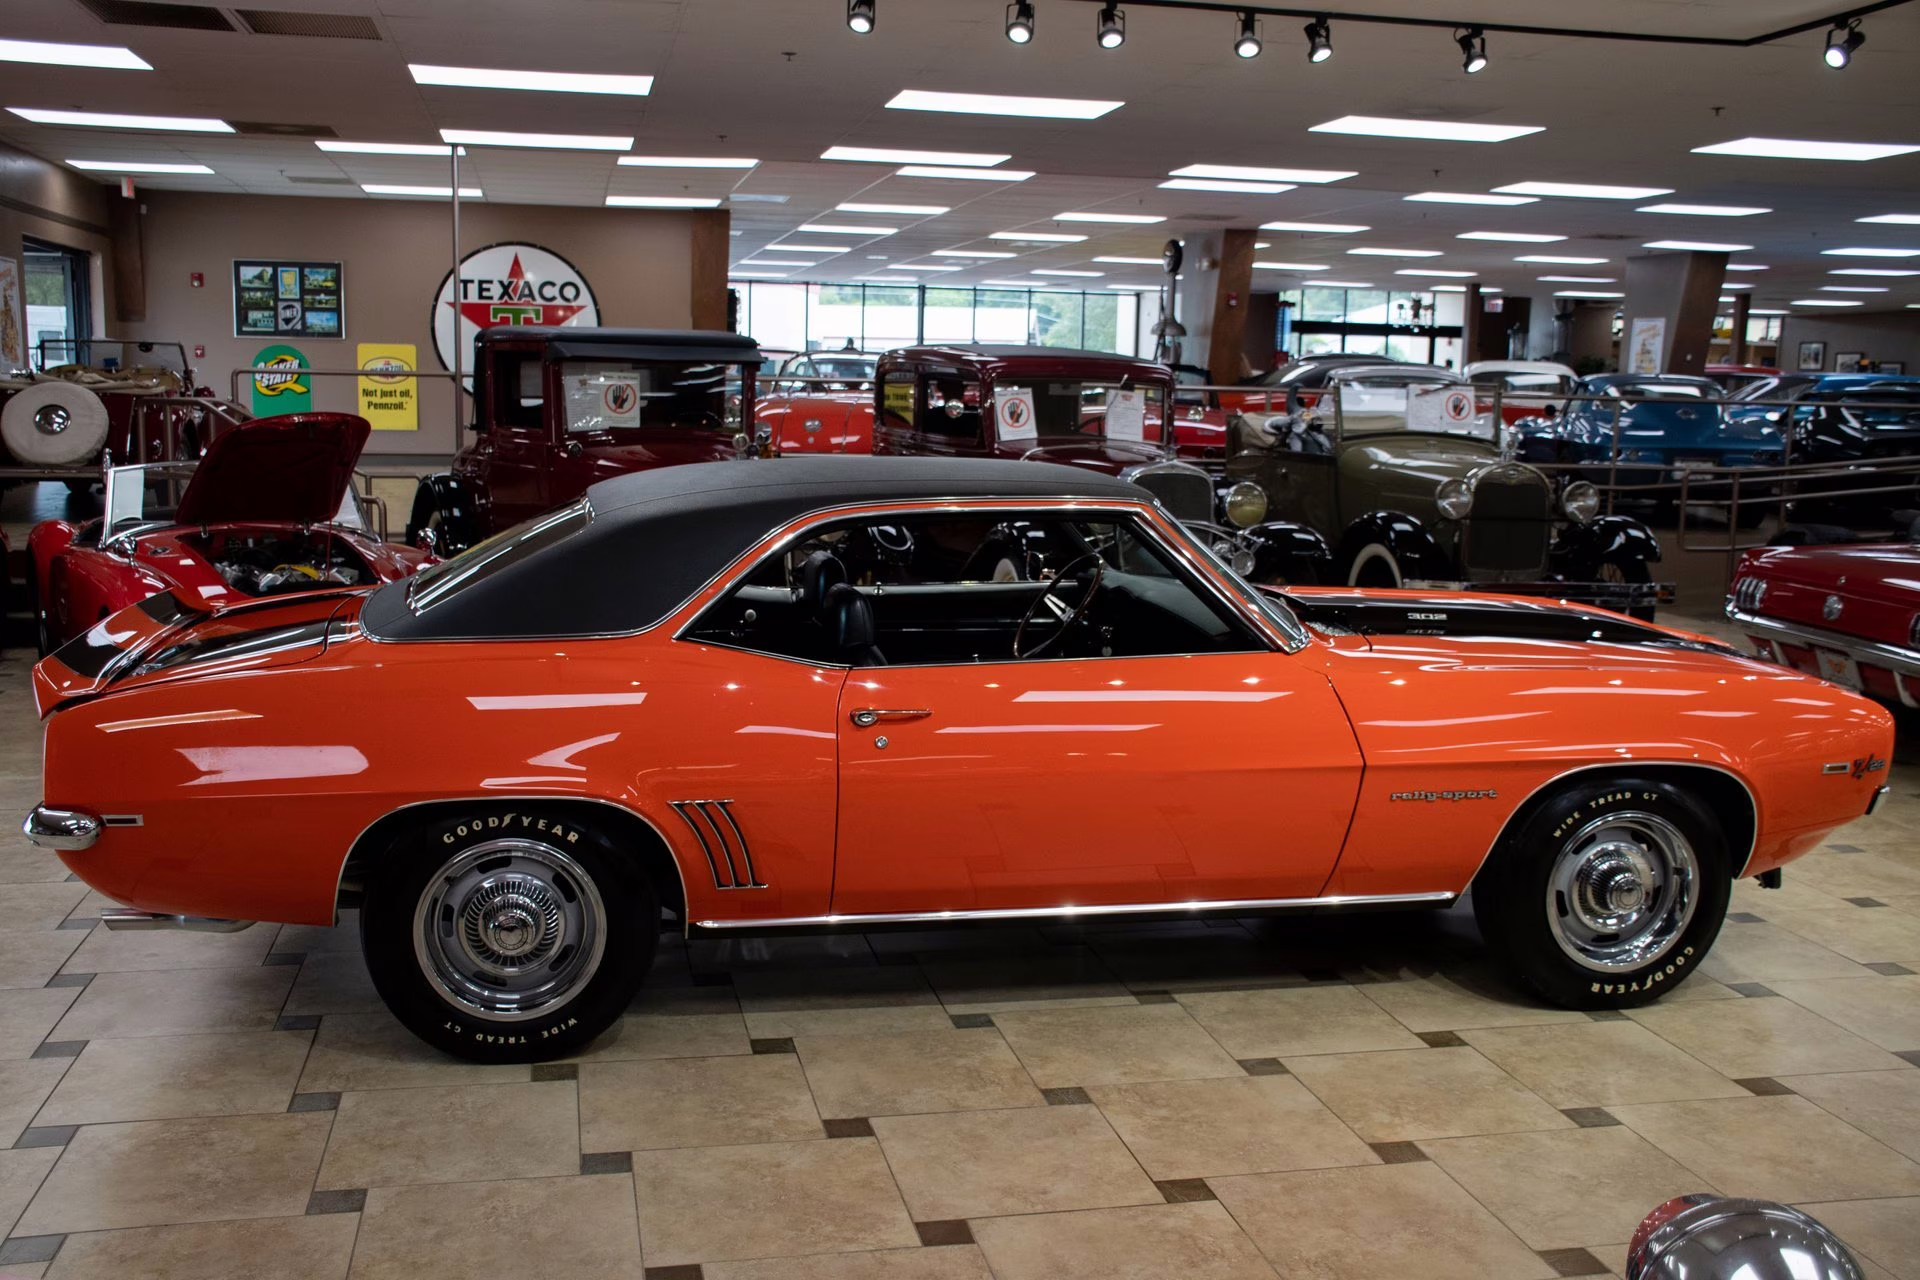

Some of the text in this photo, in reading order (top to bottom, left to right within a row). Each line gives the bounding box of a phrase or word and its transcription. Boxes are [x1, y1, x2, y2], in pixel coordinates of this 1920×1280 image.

[460, 279, 580, 302] TEXACO
[362, 388, 413, 400] Not just oil,
[1407, 612, 1448, 620] 302
[1553, 791, 1658, 838] WIDE TREAD GT
[443, 813, 579, 844] GOODYEAR
[1590, 946, 1694, 994] GOODYEAR
[443, 1018, 577, 1044] WIDE TREAD GT
